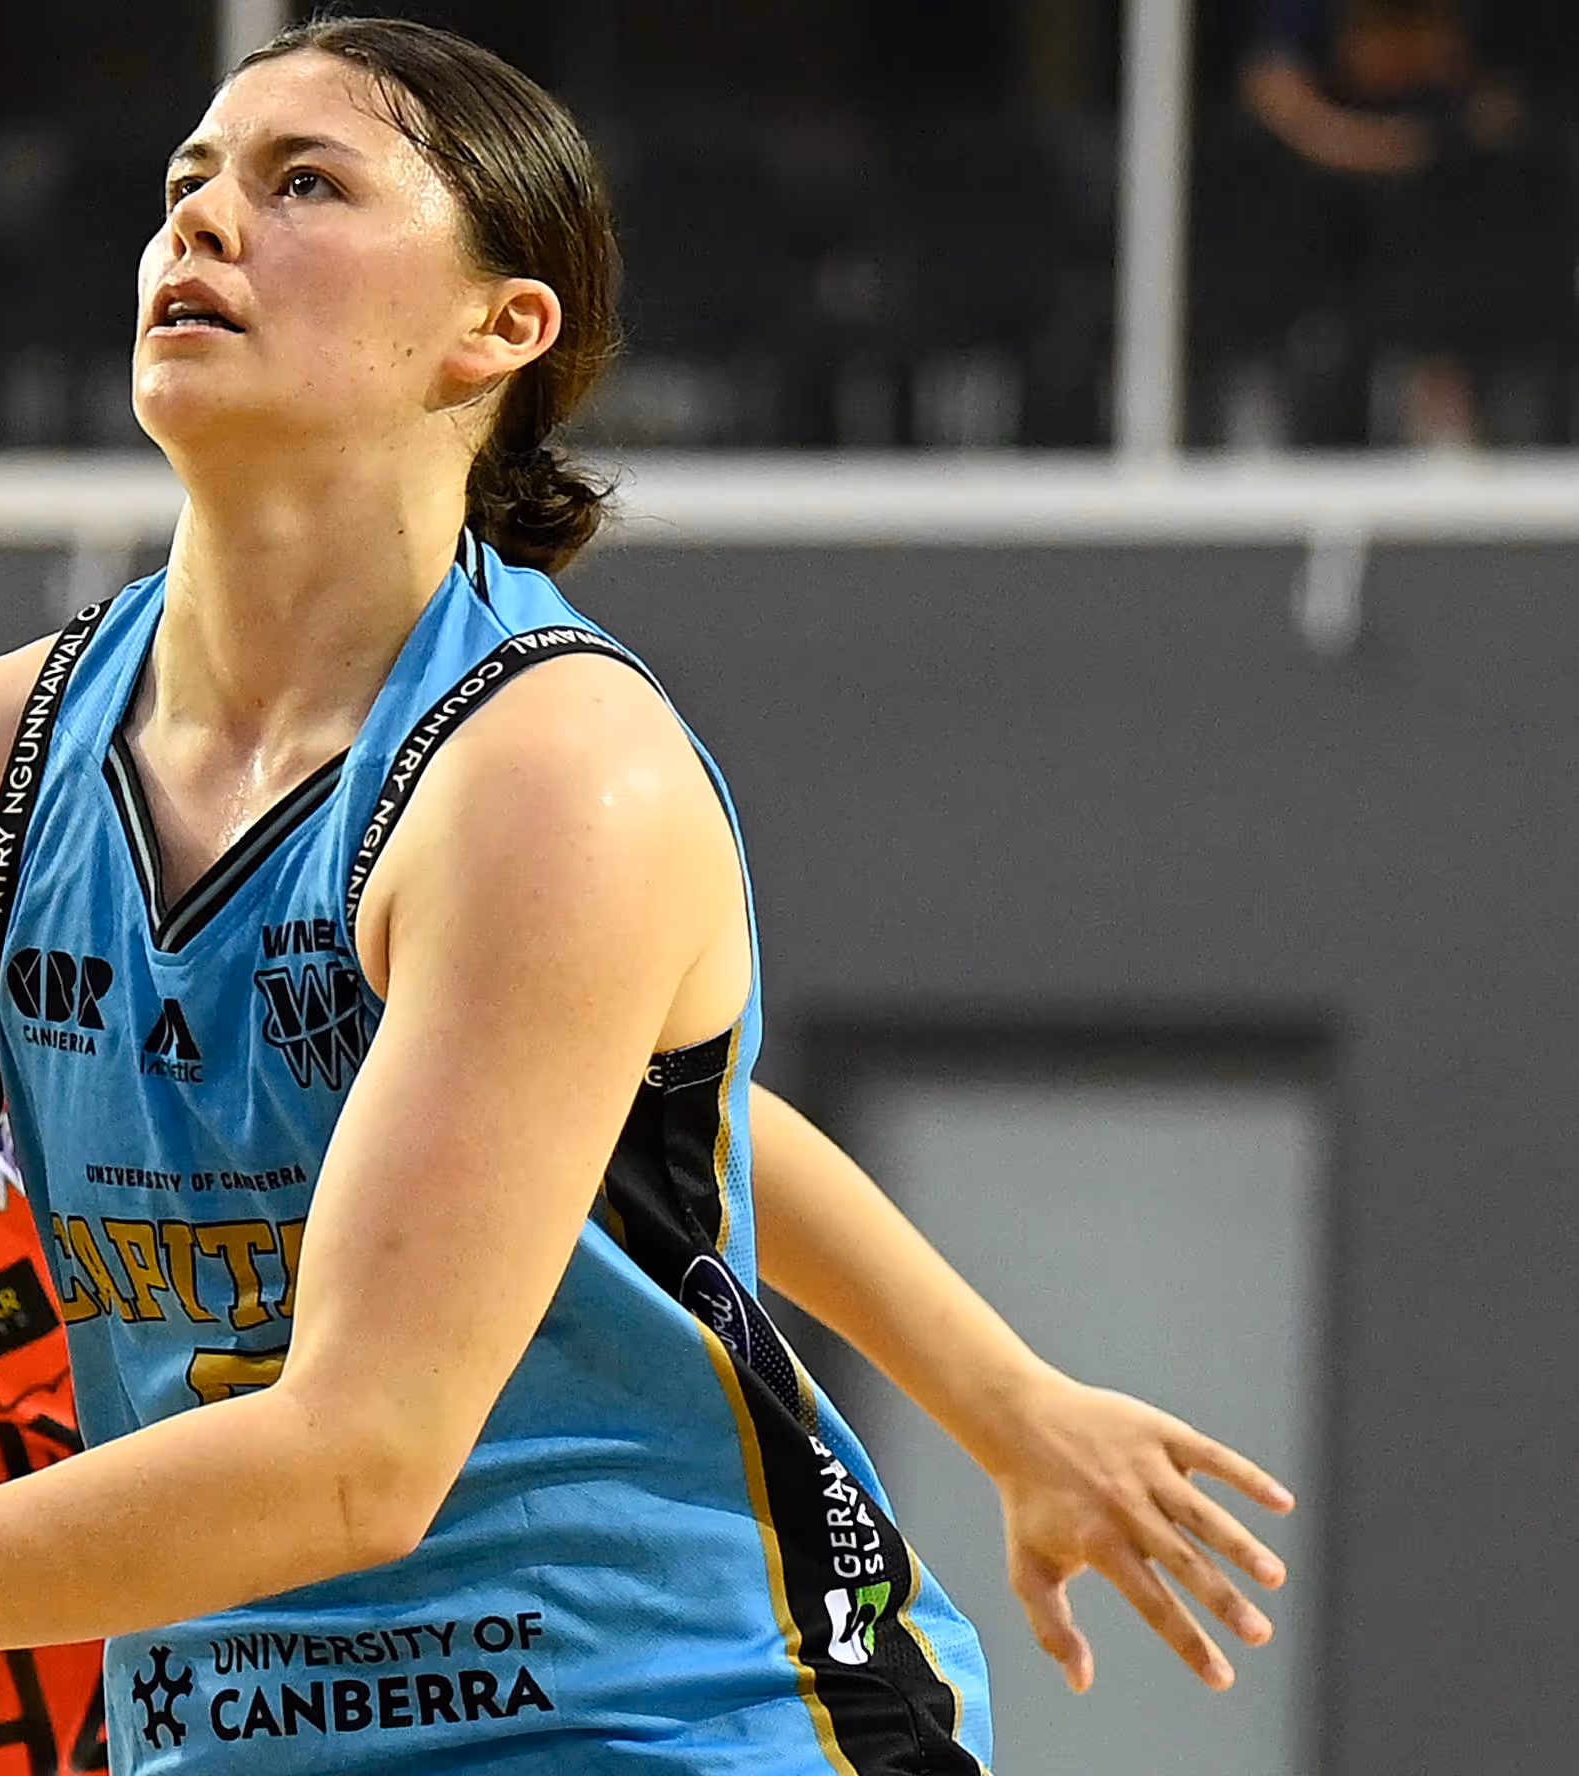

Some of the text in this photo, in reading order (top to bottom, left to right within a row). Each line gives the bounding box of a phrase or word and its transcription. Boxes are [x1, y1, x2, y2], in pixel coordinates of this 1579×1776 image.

[2, 626, 90, 815] NGUNNAWAL
[392, 661, 504, 793] COUNTRY
[85, 1163, 182, 1192] UNIVERSITY
[191, 1172, 216, 1192] OF
[210, 1612, 543, 1675] UNIVERSITY OF
[210, 1665, 555, 1742] CANBERRA
